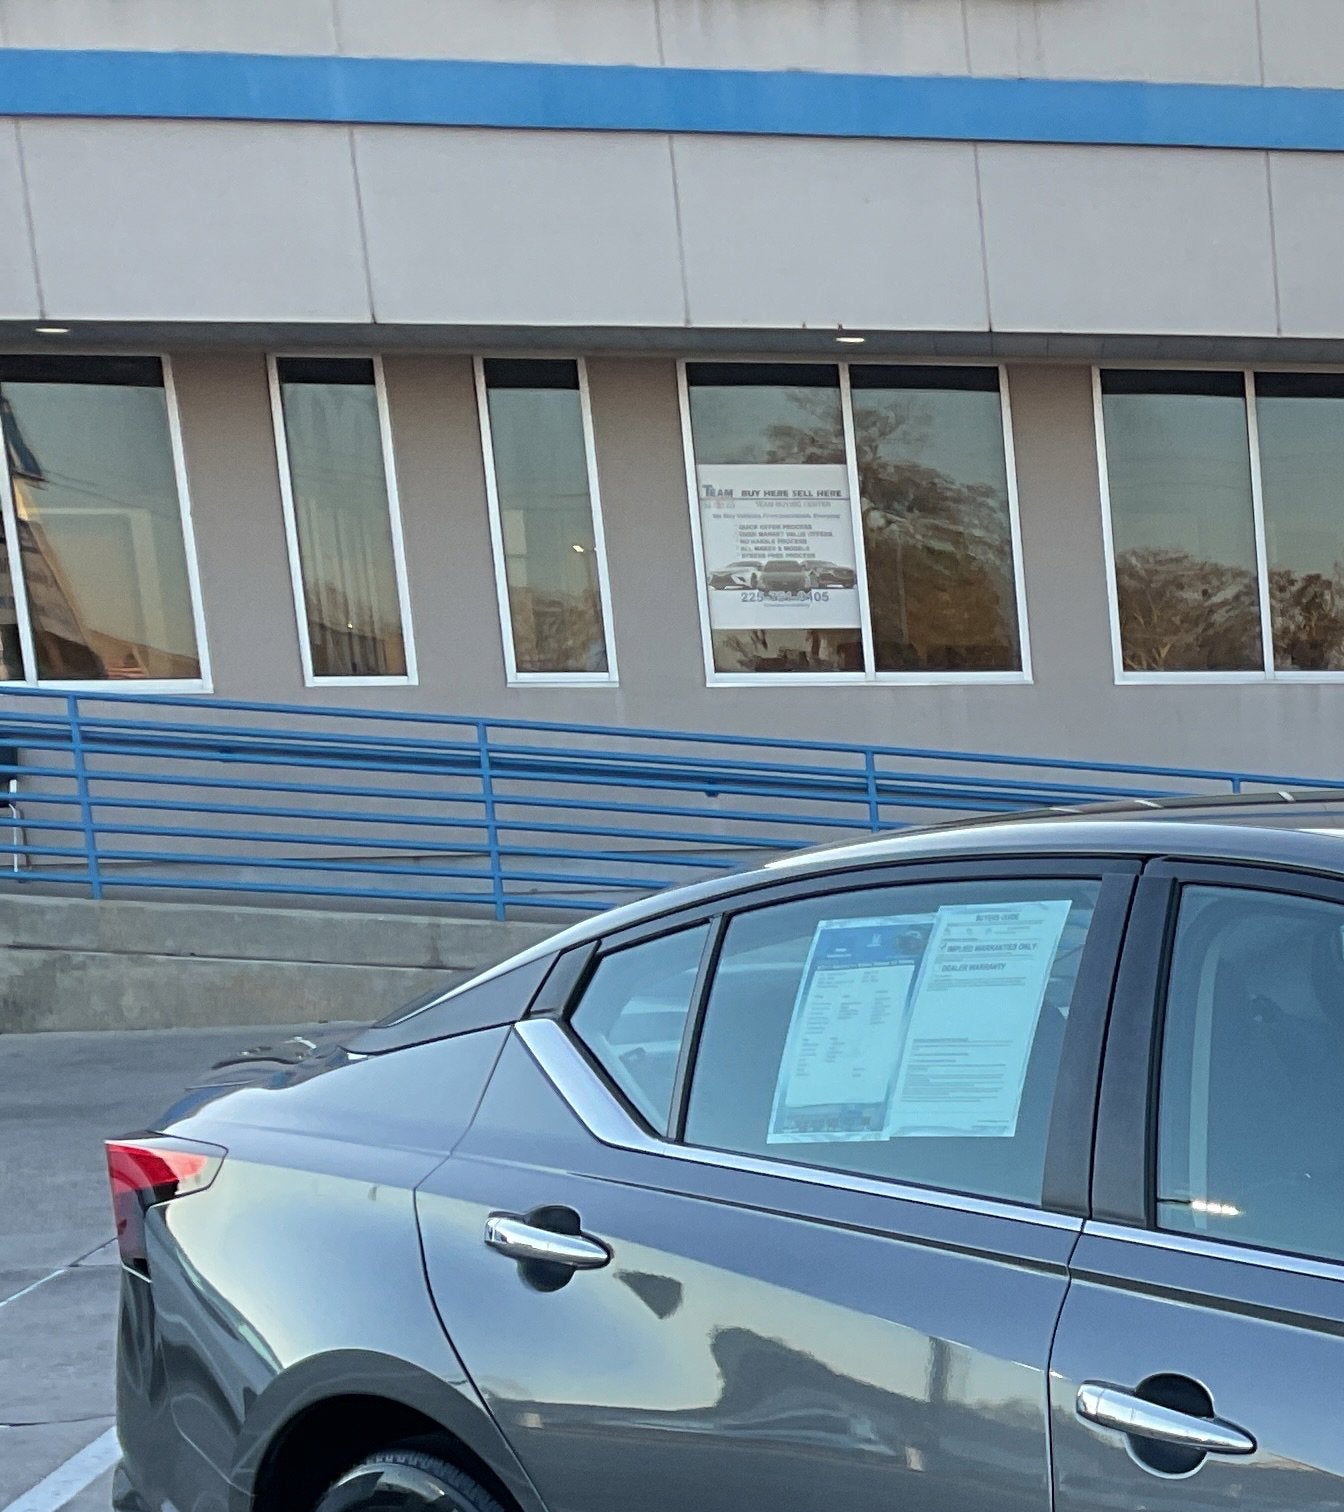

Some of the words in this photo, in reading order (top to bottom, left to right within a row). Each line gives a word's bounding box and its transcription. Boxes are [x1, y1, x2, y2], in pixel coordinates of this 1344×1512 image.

[702, 484, 734, 497] TEAM
[741, 489, 760, 497] BUY
[763, 489, 789, 497] HERE
[792, 489, 813, 497] SELL
[817, 489, 842, 497] HERE
